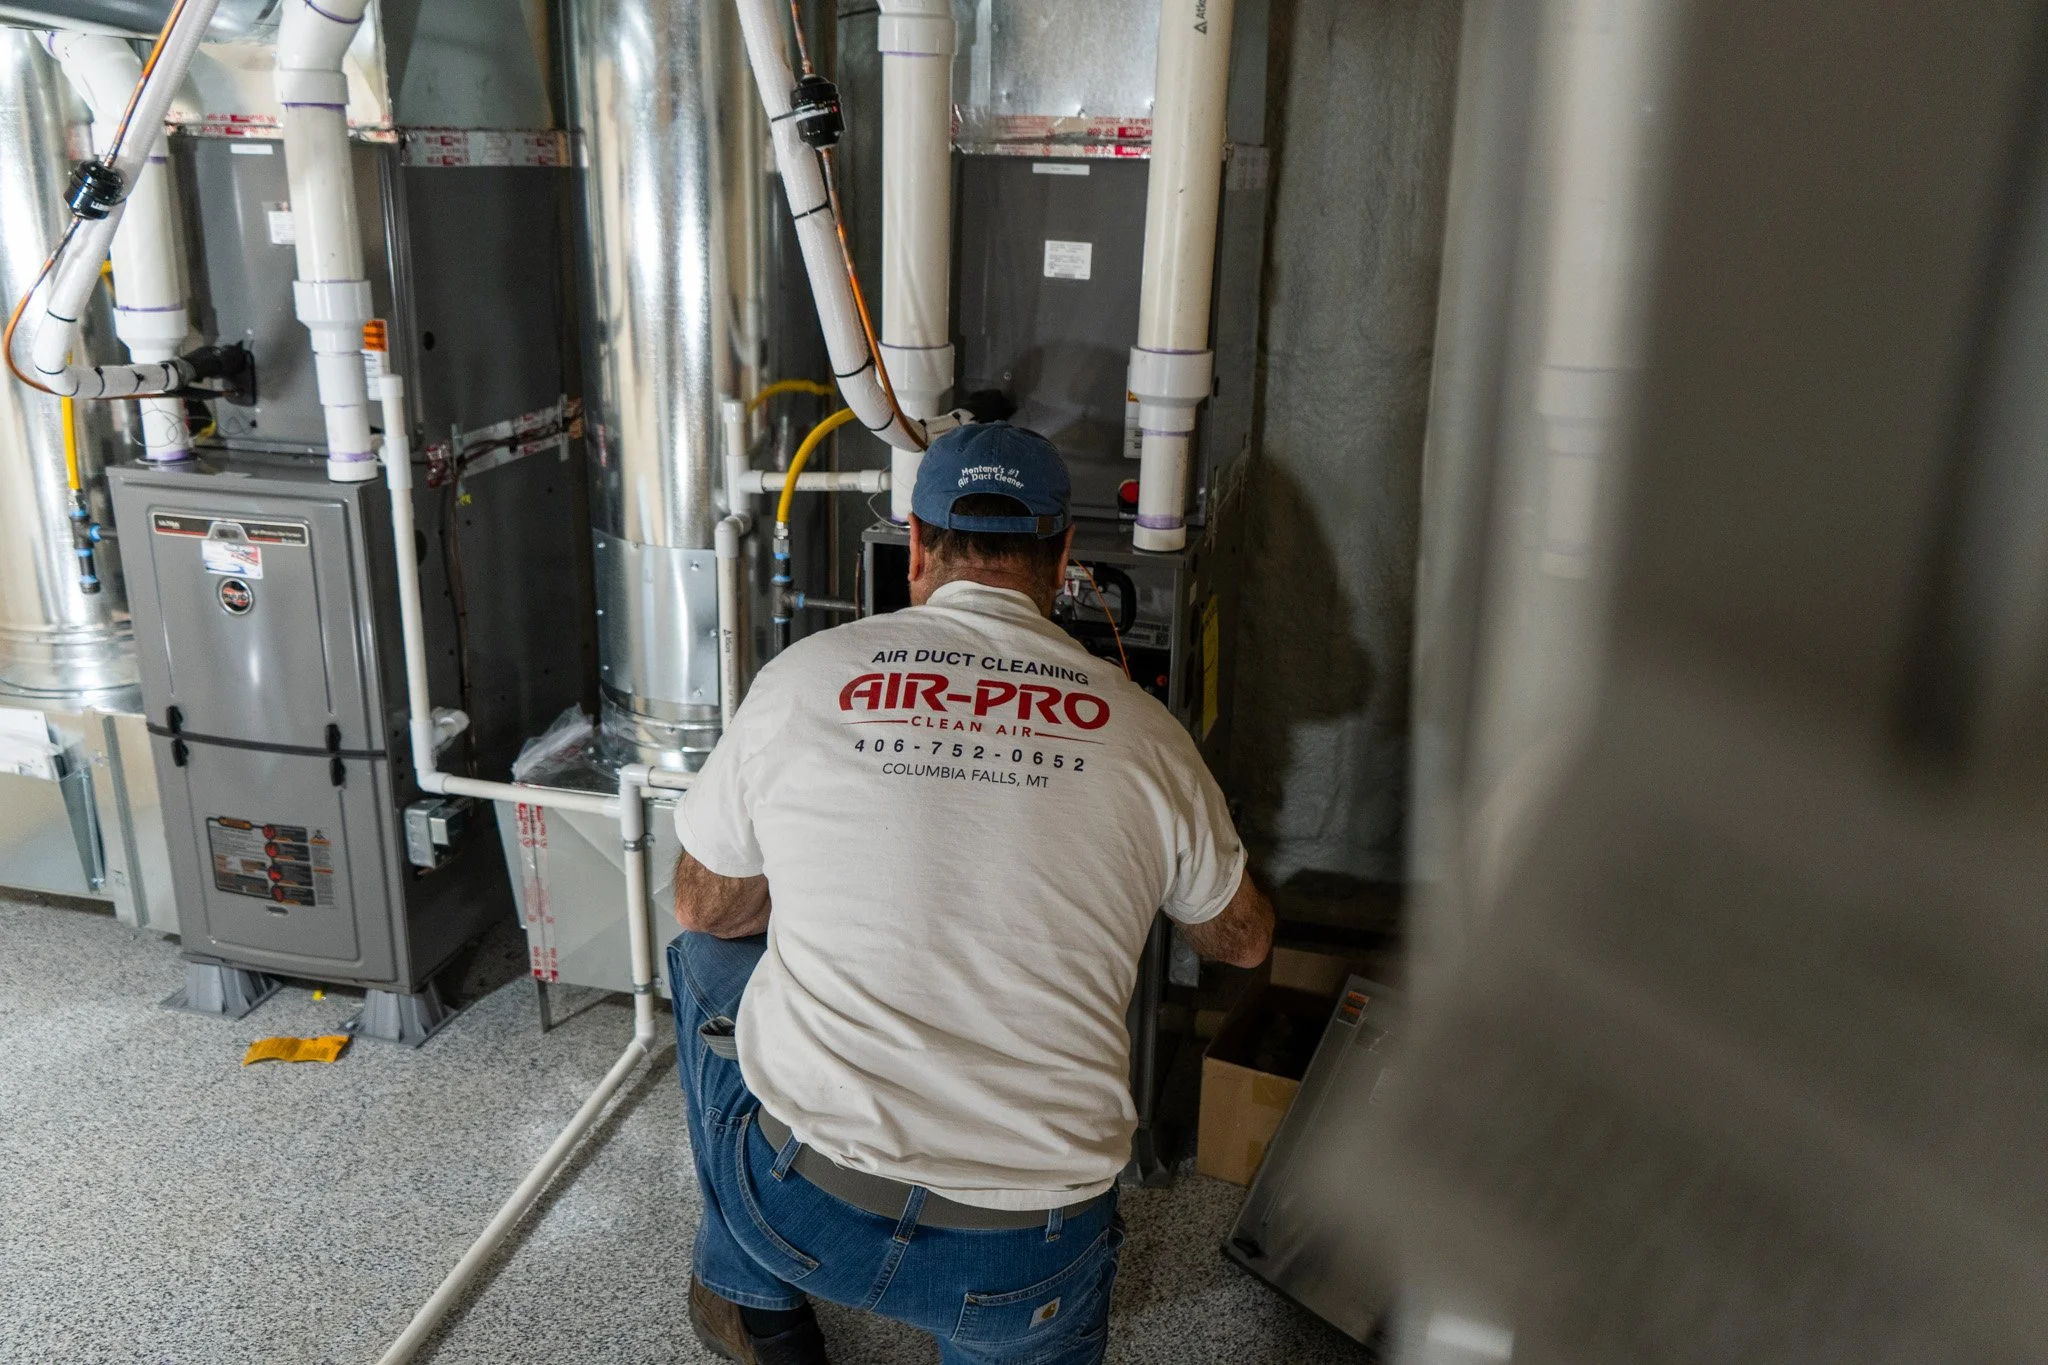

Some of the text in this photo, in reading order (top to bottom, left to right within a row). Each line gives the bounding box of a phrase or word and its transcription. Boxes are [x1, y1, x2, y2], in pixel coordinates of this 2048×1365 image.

[957, 473, 1025, 489] Air Duct Cleaner
[961, 465, 1020, 478] Montana's #1
[871, 649, 1089, 686] AIR DUCT CLEANING
[838, 672, 1111, 731] AIR-PRO
[911, 715, 1032, 738] CLEAN AIR
[854, 738, 1085, 772] 406-752-0652
[882, 762, 1049, 788] COLUMBIA FALLS, MT
